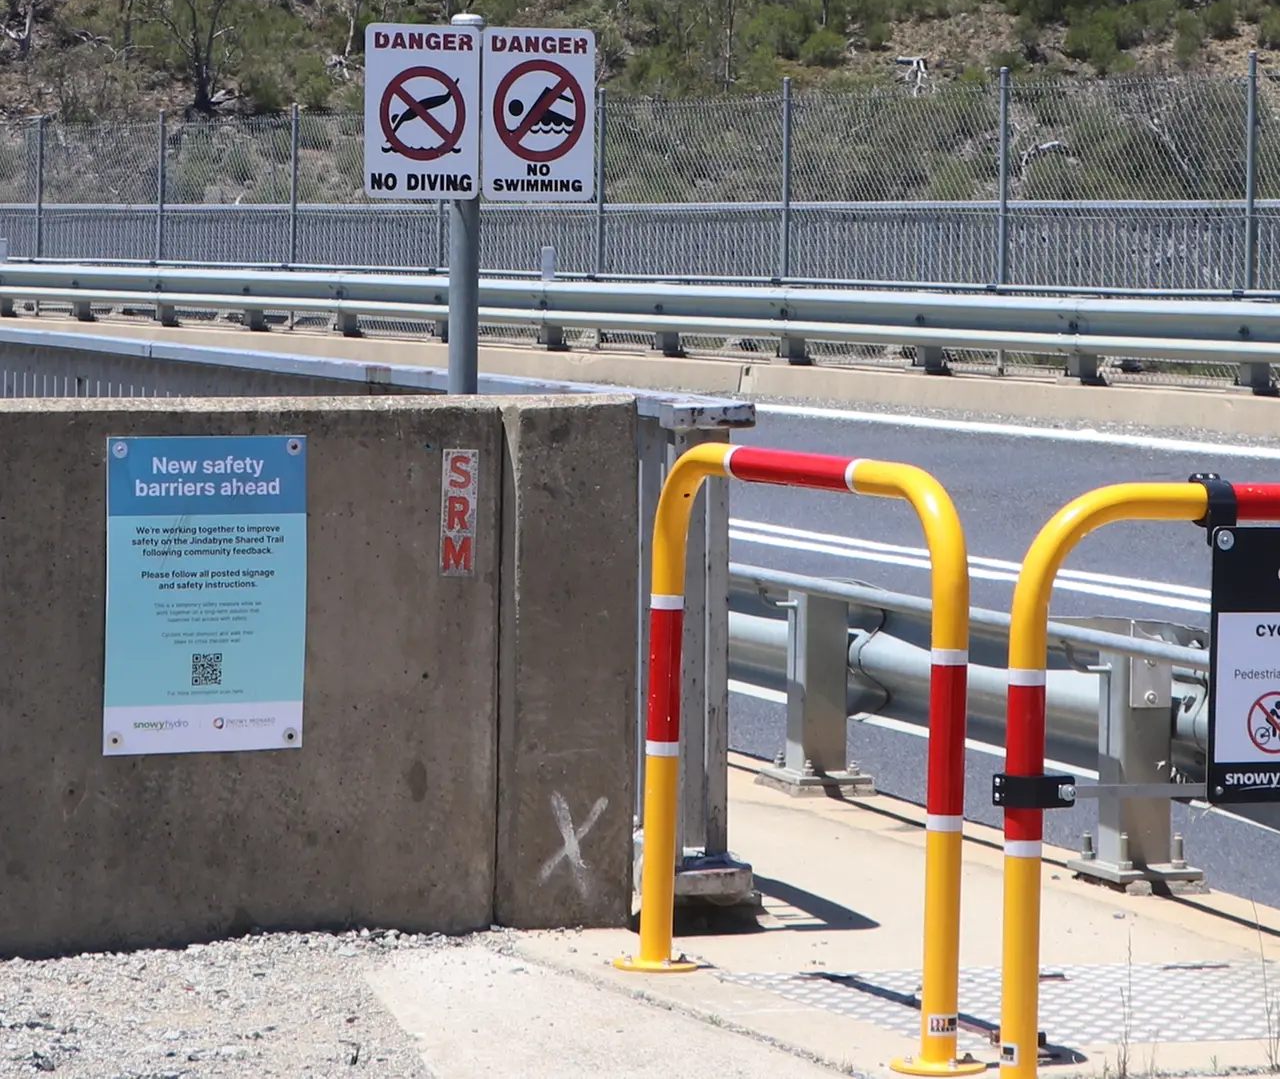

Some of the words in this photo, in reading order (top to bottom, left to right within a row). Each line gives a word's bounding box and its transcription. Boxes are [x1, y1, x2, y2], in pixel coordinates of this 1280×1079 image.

[374, 32, 473, 51] DANGER
[491, 35, 588, 54] DANGER
[527, 164, 550, 176] NO
[370, 173, 397, 191] NO
[407, 174, 472, 192] DIVING
[493, 179, 583, 192] SWIMMING
[152, 456, 197, 474] New
[203, 455, 264, 477] safety
[135, 479, 215, 496] barriers
[220, 478, 280, 495] ahead
[136, 526, 160, 534] We're
[162, 526, 197, 535] working
[198, 525, 235, 535] together
[247, 525, 280, 534] improve
[132, 538, 159, 547] safety
[189, 537, 233, 546] Jindabyne
[266, 535, 284, 543] Trail
[142, 548, 182, 558] following
[184, 548, 231, 556] community
[233, 547, 274, 555] feedback.
[141, 571, 170, 579] Please
[171, 570, 197, 578] follow
[211, 570, 240, 579] posted
[242, 568, 275, 578] signage
[176, 581, 203, 590] safety
[204, 580, 258, 588] instructions.
[133, 720, 188, 730] snowyhydro
